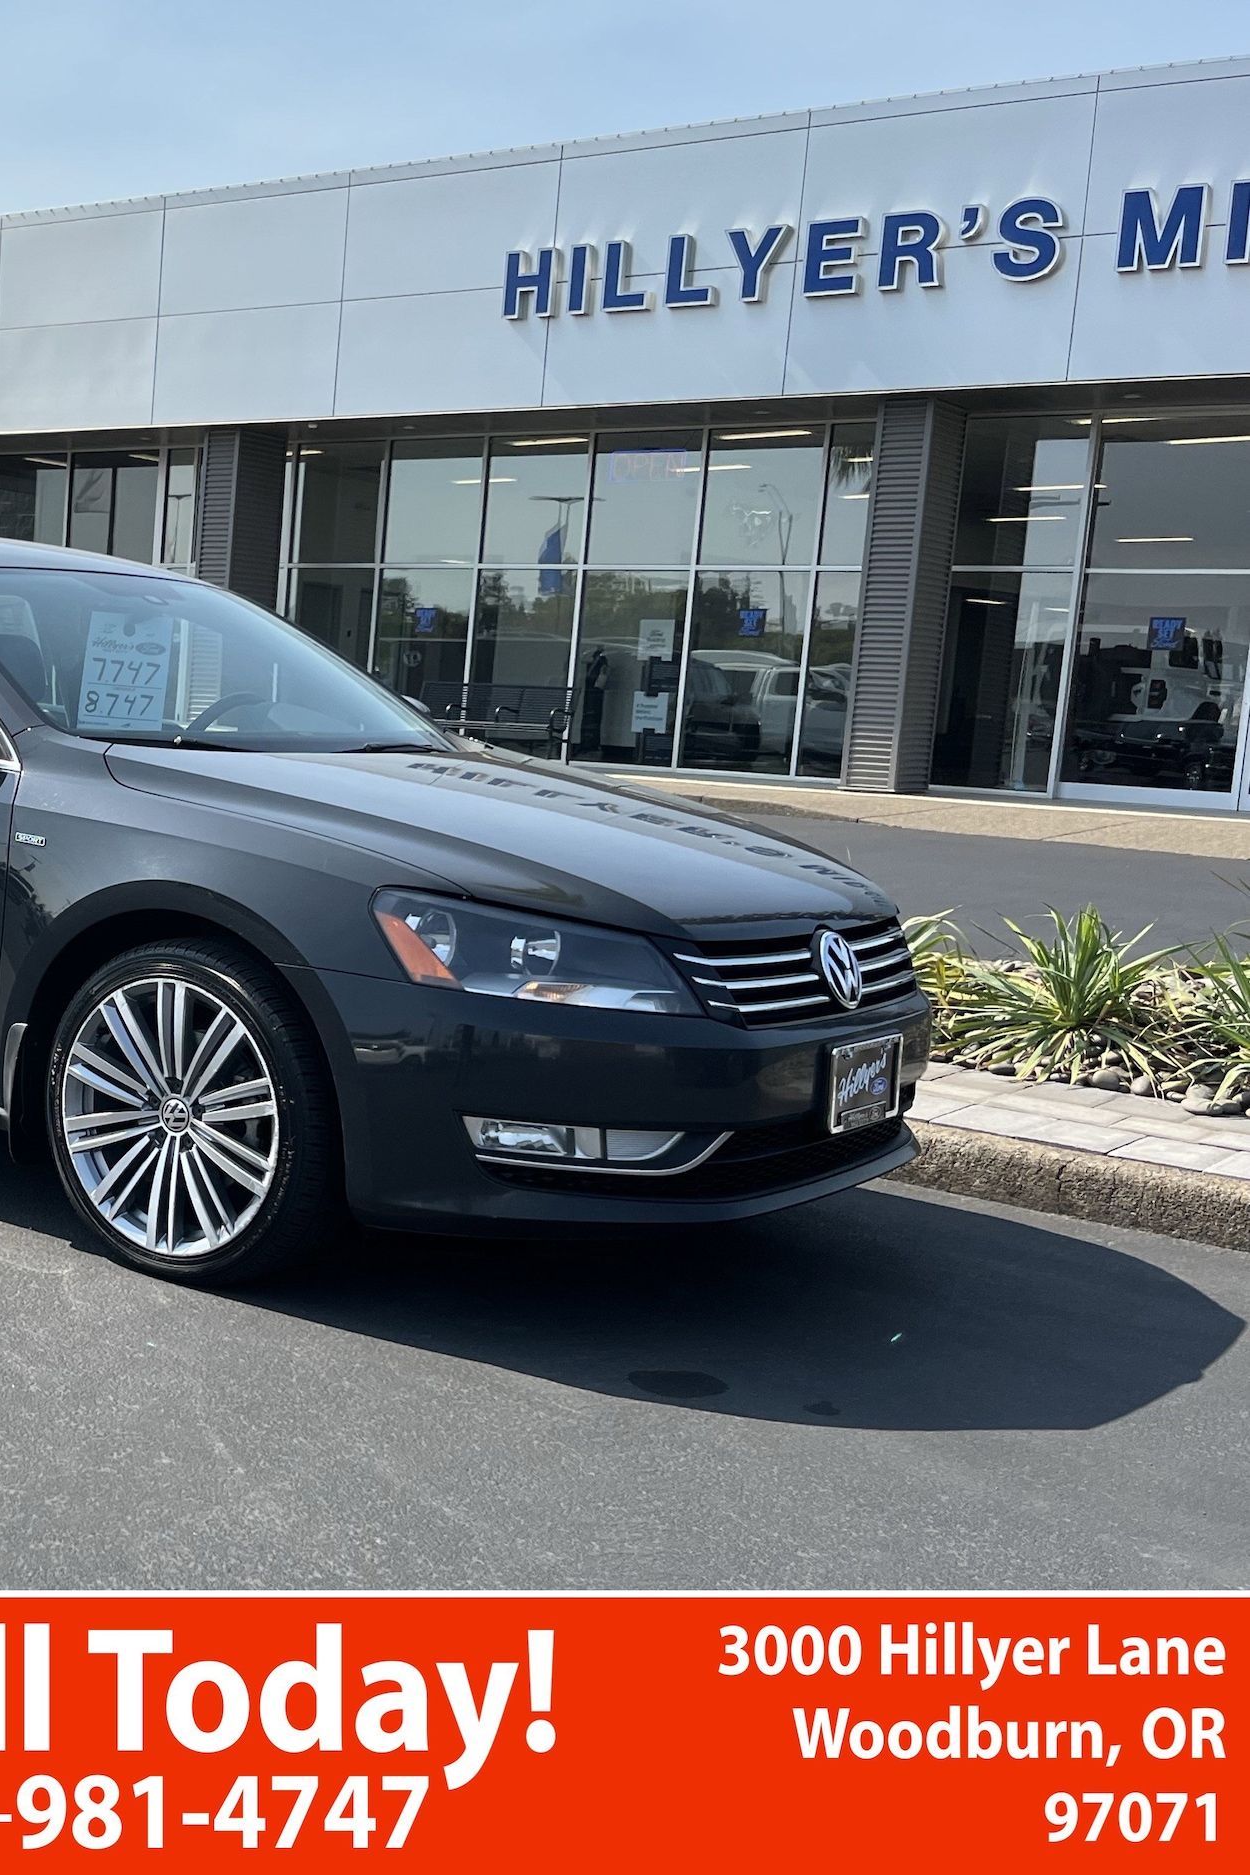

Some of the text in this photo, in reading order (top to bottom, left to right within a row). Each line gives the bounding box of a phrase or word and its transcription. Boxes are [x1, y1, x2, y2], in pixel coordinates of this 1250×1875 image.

[502, 197, 1068, 320] HILLYER'S
[611, 453, 685, 480] OPEN
[837, 1048, 887, 1107] Hillyer's
